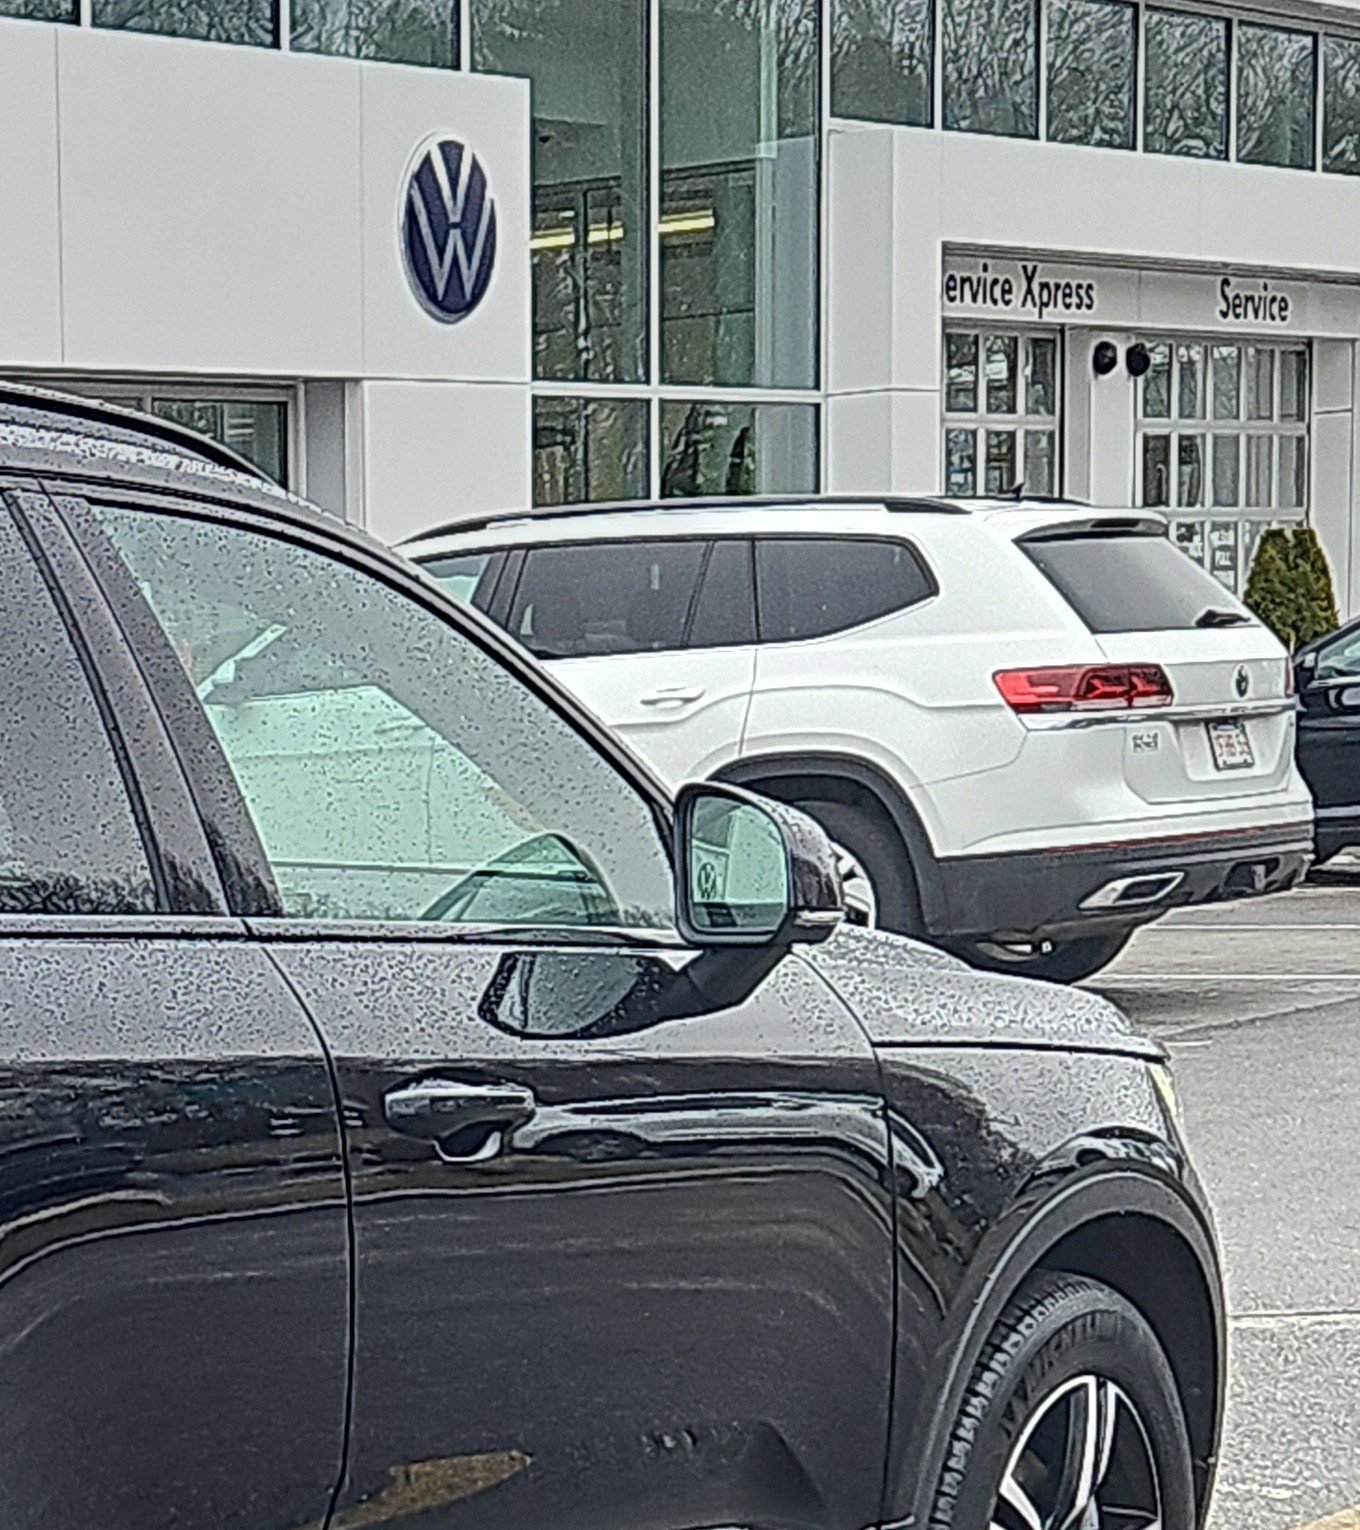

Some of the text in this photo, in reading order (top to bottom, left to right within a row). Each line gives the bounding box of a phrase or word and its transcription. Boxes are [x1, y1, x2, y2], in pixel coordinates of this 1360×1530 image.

[944, 261, 1095, 319] ervice Xpress
[1219, 277, 1290, 322] Service
